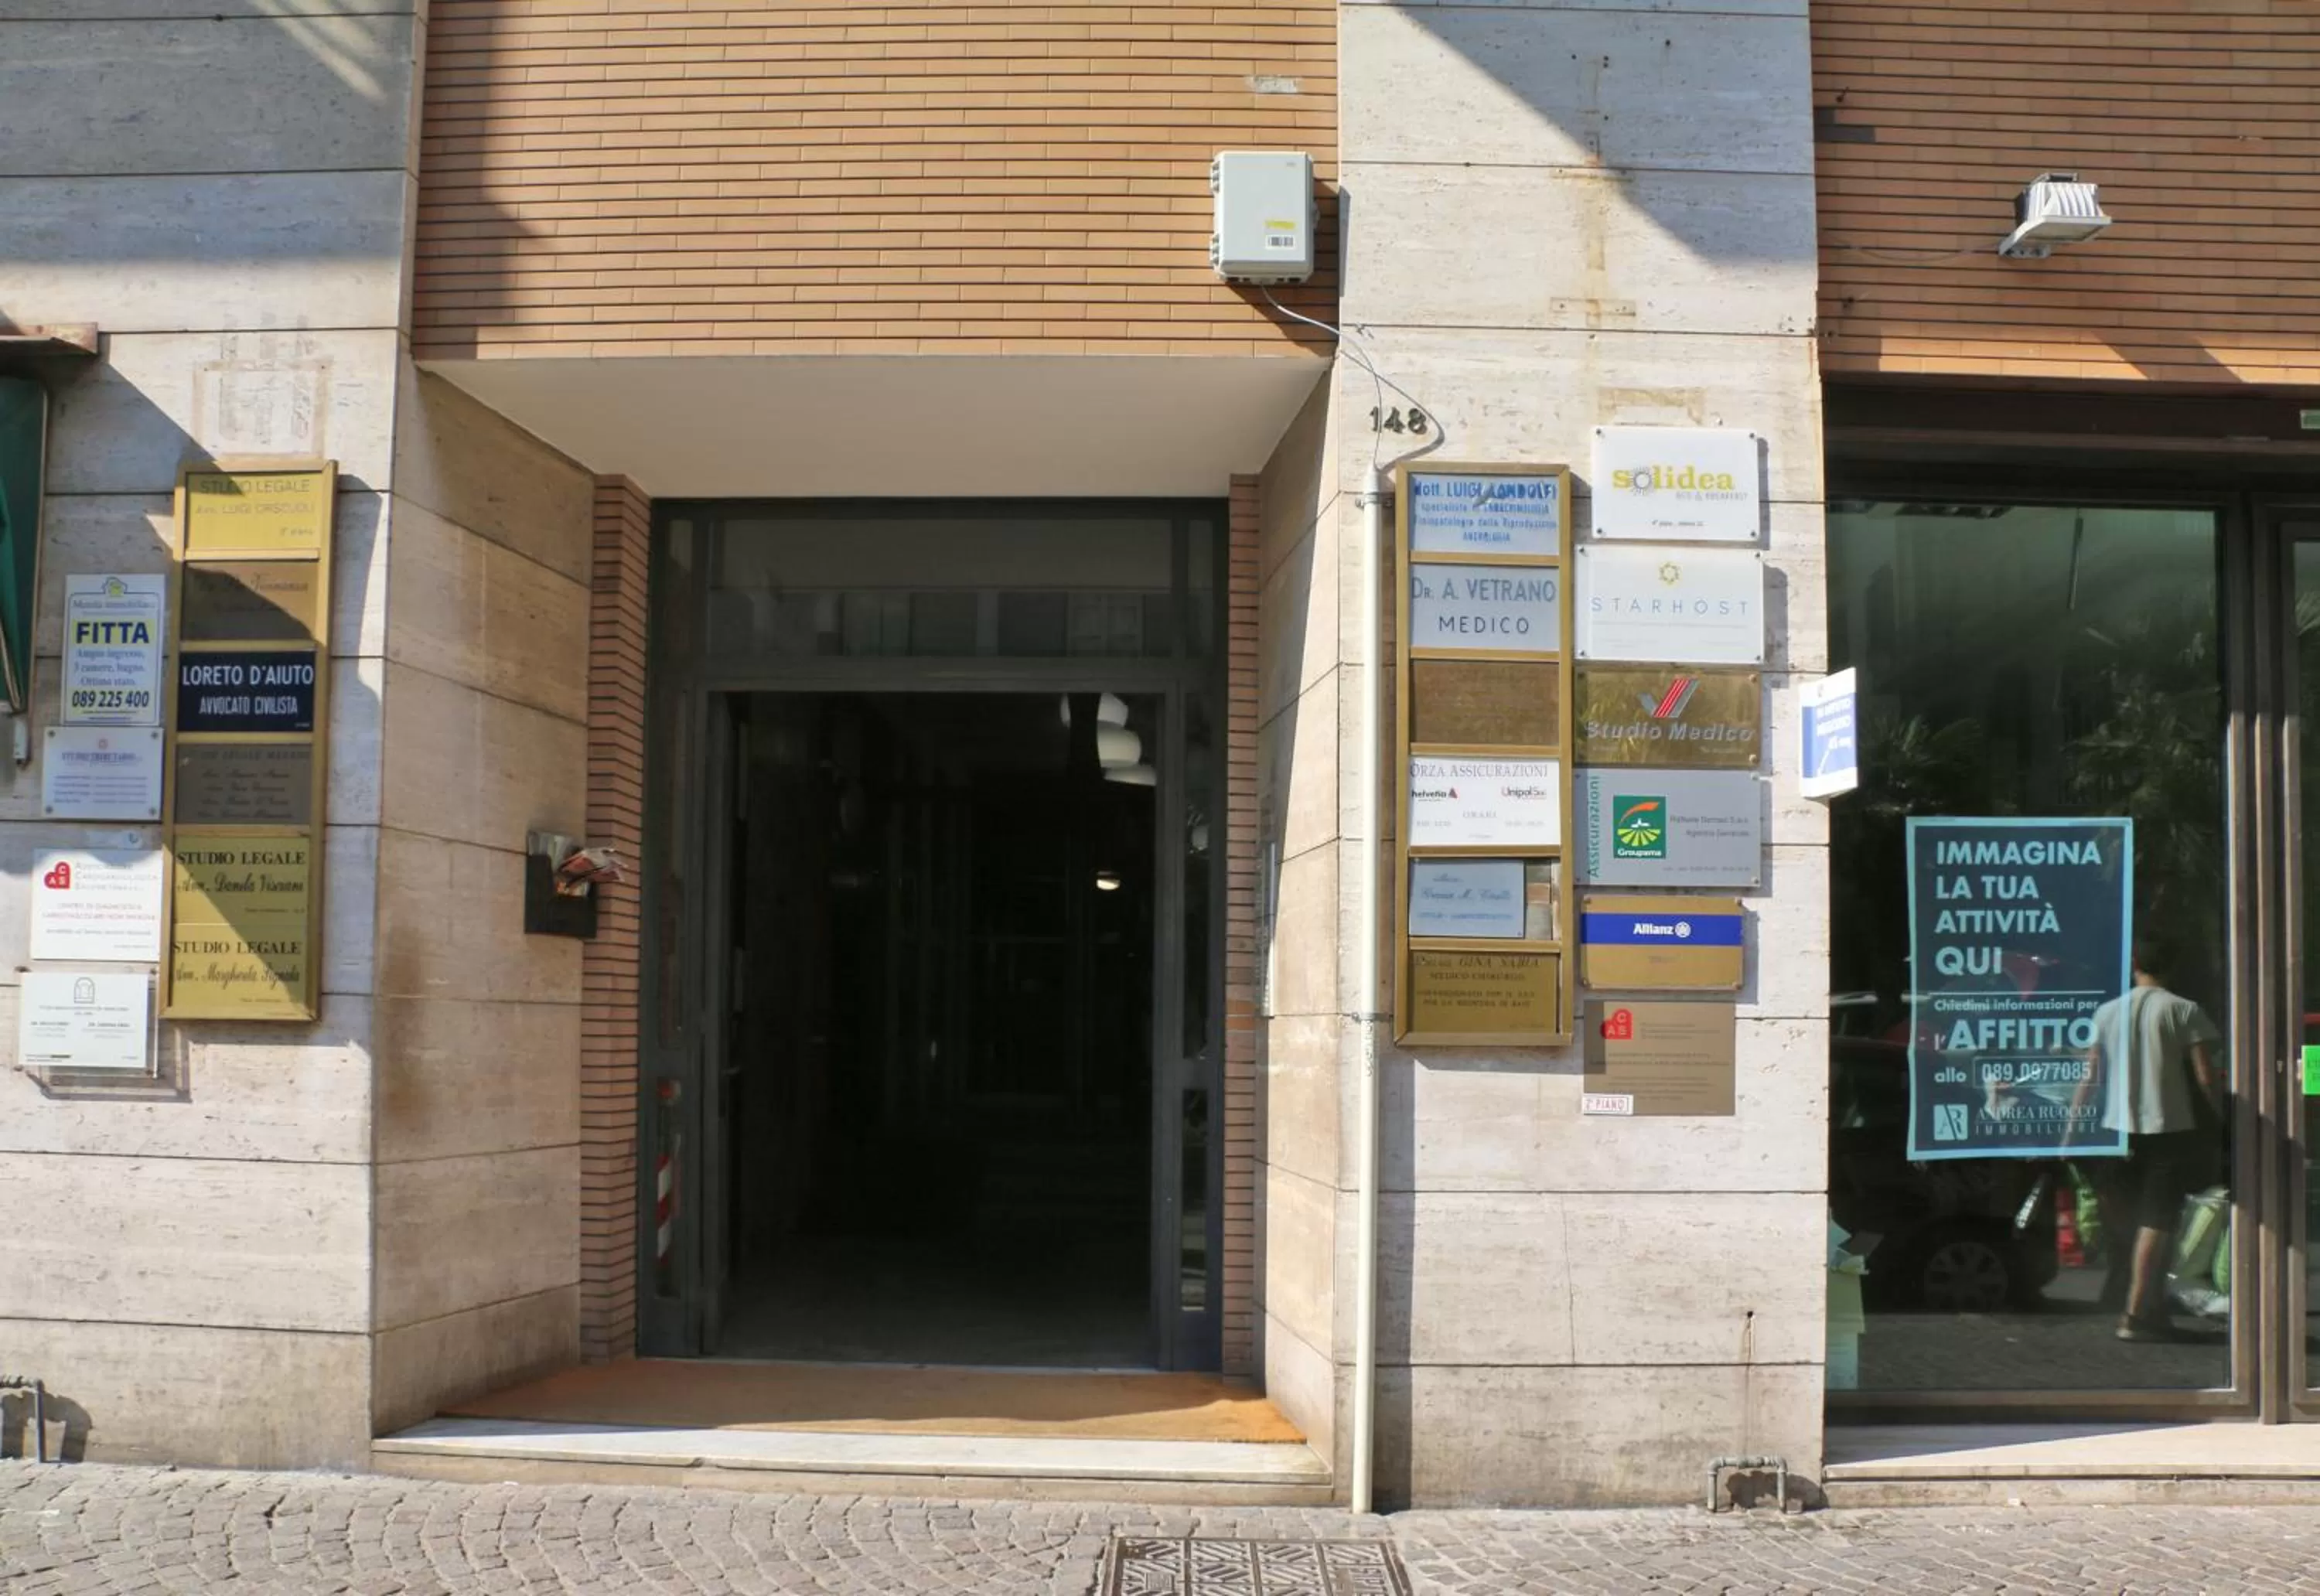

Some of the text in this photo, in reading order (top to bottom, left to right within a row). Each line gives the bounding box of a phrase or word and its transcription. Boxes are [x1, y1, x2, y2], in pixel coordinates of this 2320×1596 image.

[1369, 405, 1428, 435] 148
[256, 479, 310, 493] LEGALE
[1612, 464, 1735, 492] solidea
[1466, 578, 1557, 603] VETRANO
[1592, 597, 1749, 616] STARHOST
[76, 621, 150, 644] FITTA
[1439, 616, 1530, 634] MEDICO
[183, 665, 314, 686] LORETO D'AIUTO
[72, 690, 150, 708] 089 225 400
[199, 696, 251, 715] AVVOCATO
[1587, 720, 1754, 742] Studio Medico
[1450, 763, 1548, 778] ASSICURAZIONI
[1589, 776, 1600, 878] Assicurazioni
[176, 851, 306, 865] STUDIO LEGALE
[1617, 847, 1662, 858] Groupama
[1936, 841, 2102, 865] IMMAGINA
[1936, 876, 2039, 900] LA TUA
[1935, 903, 2061, 933] ATTIVITÀ
[1633, 922, 1674, 936] Allianz
[175, 941, 302, 954] STUDIO LEGALE
[1935, 946, 2003, 976] QUI
[1935, 999, 1990, 1012] Chiedimi
[1993, 998, 2075, 1011] informazioni
[1935, 1068, 1967, 1083] allo
[2039, 1104, 2097, 1120] RUOCCO
